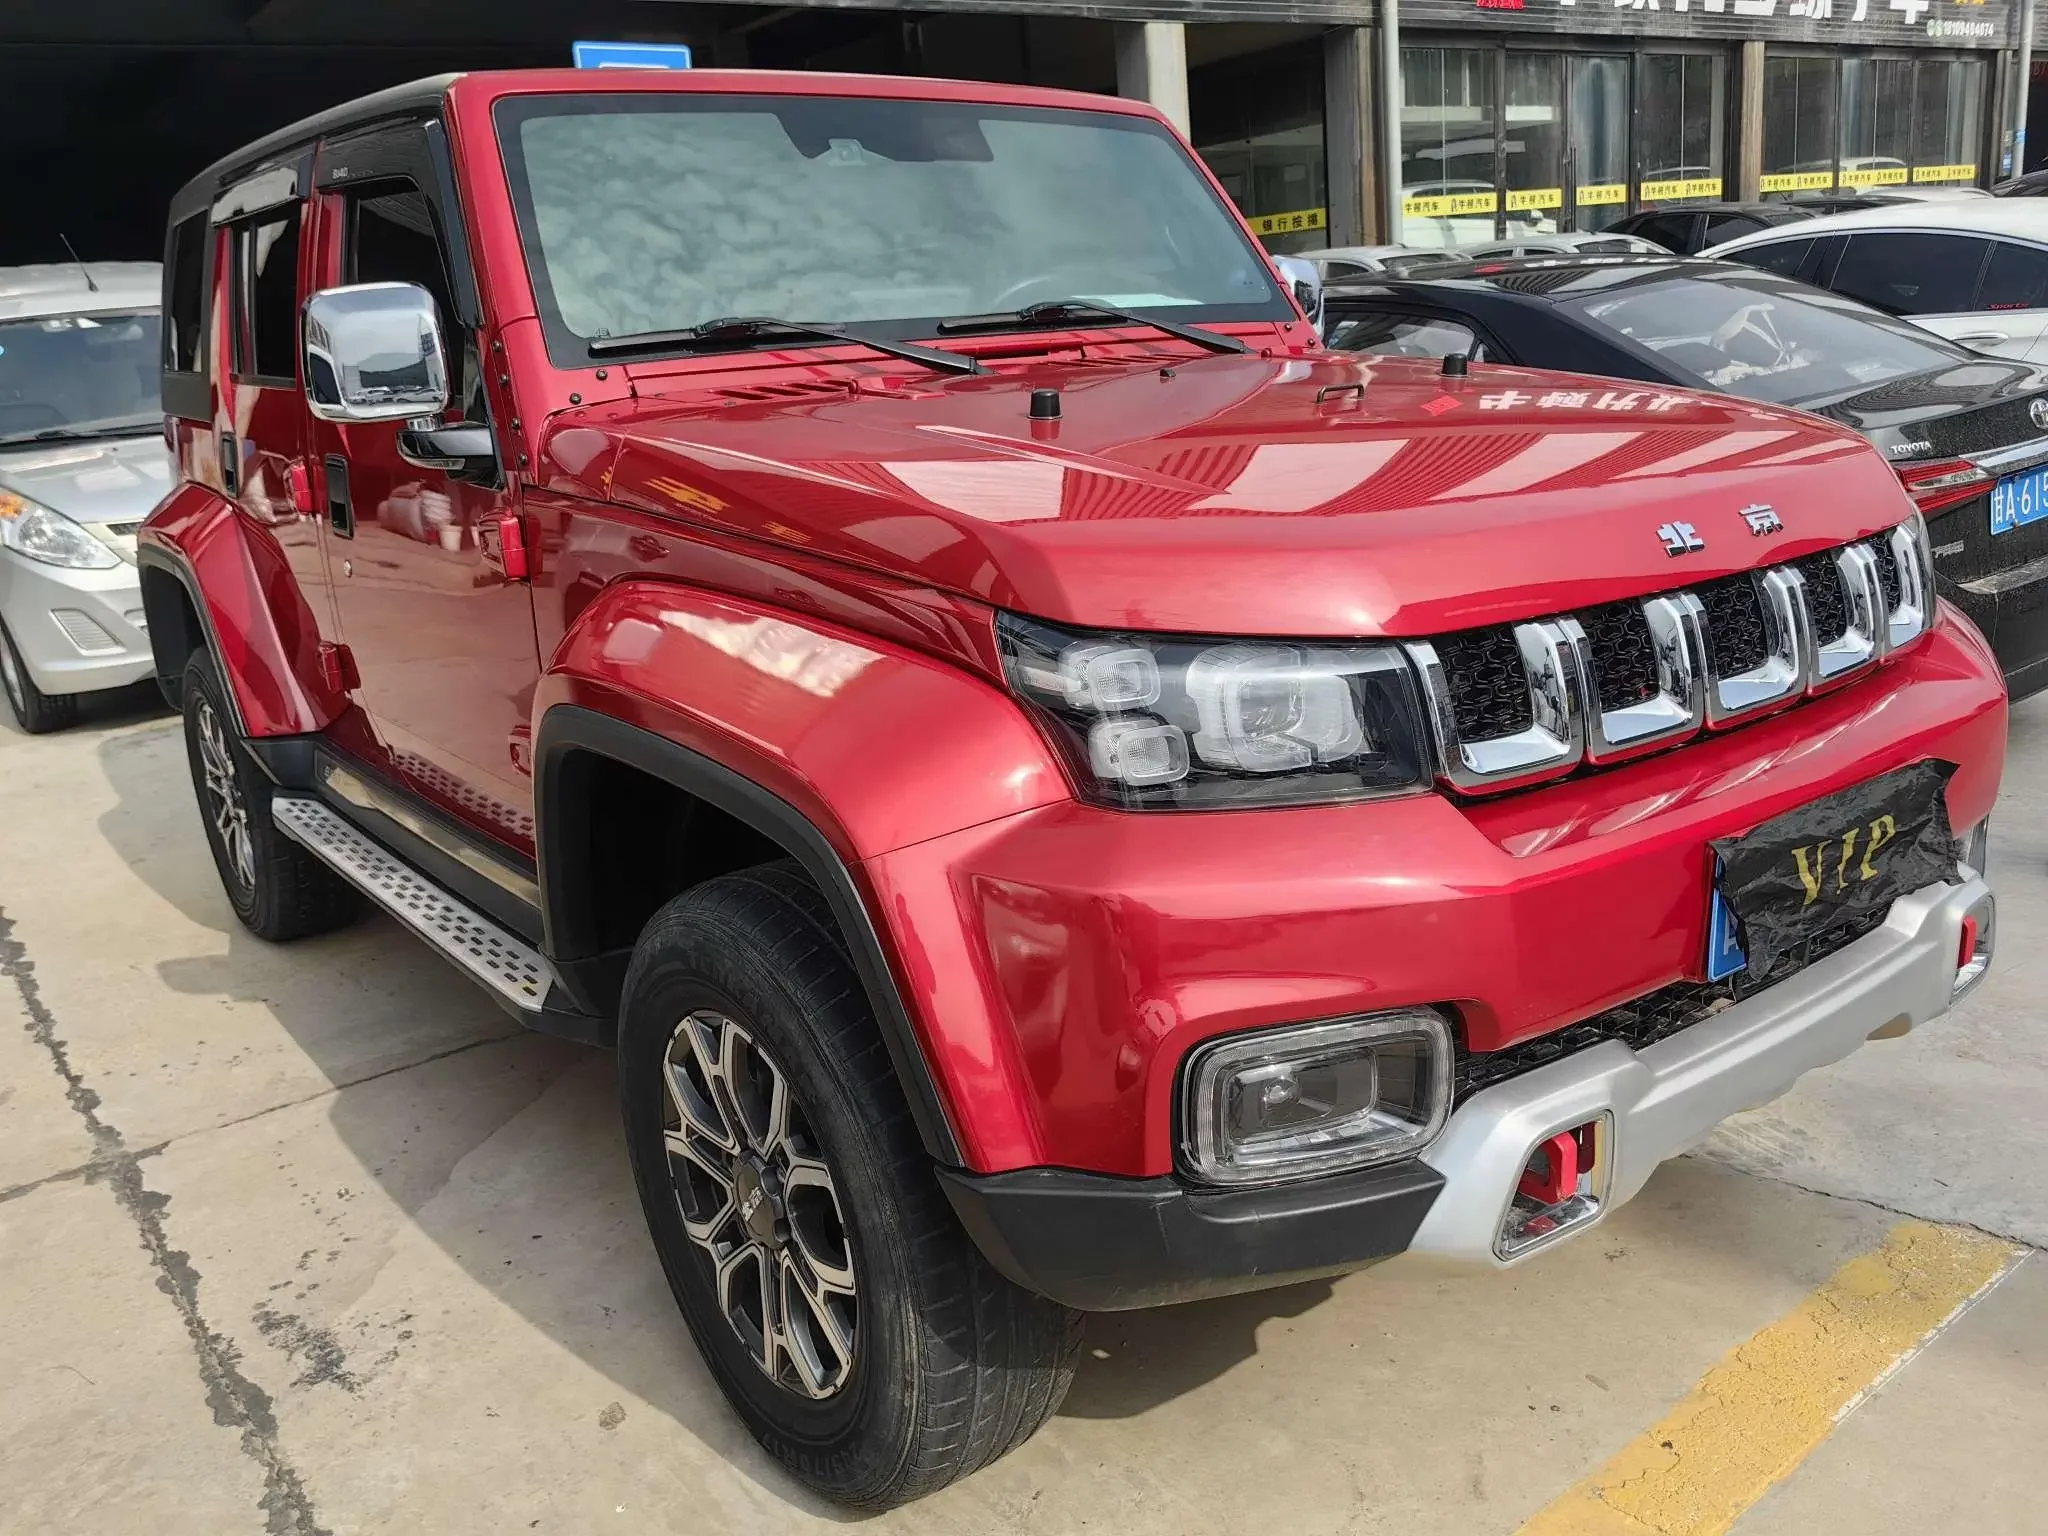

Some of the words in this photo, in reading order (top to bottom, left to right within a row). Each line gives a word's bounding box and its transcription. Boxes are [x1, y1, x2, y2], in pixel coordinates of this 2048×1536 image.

[1891, 440, 1932, 454] TOYOTA
[1656, 503, 1784, 558] 北京
[1791, 814, 1896, 905] VIP
